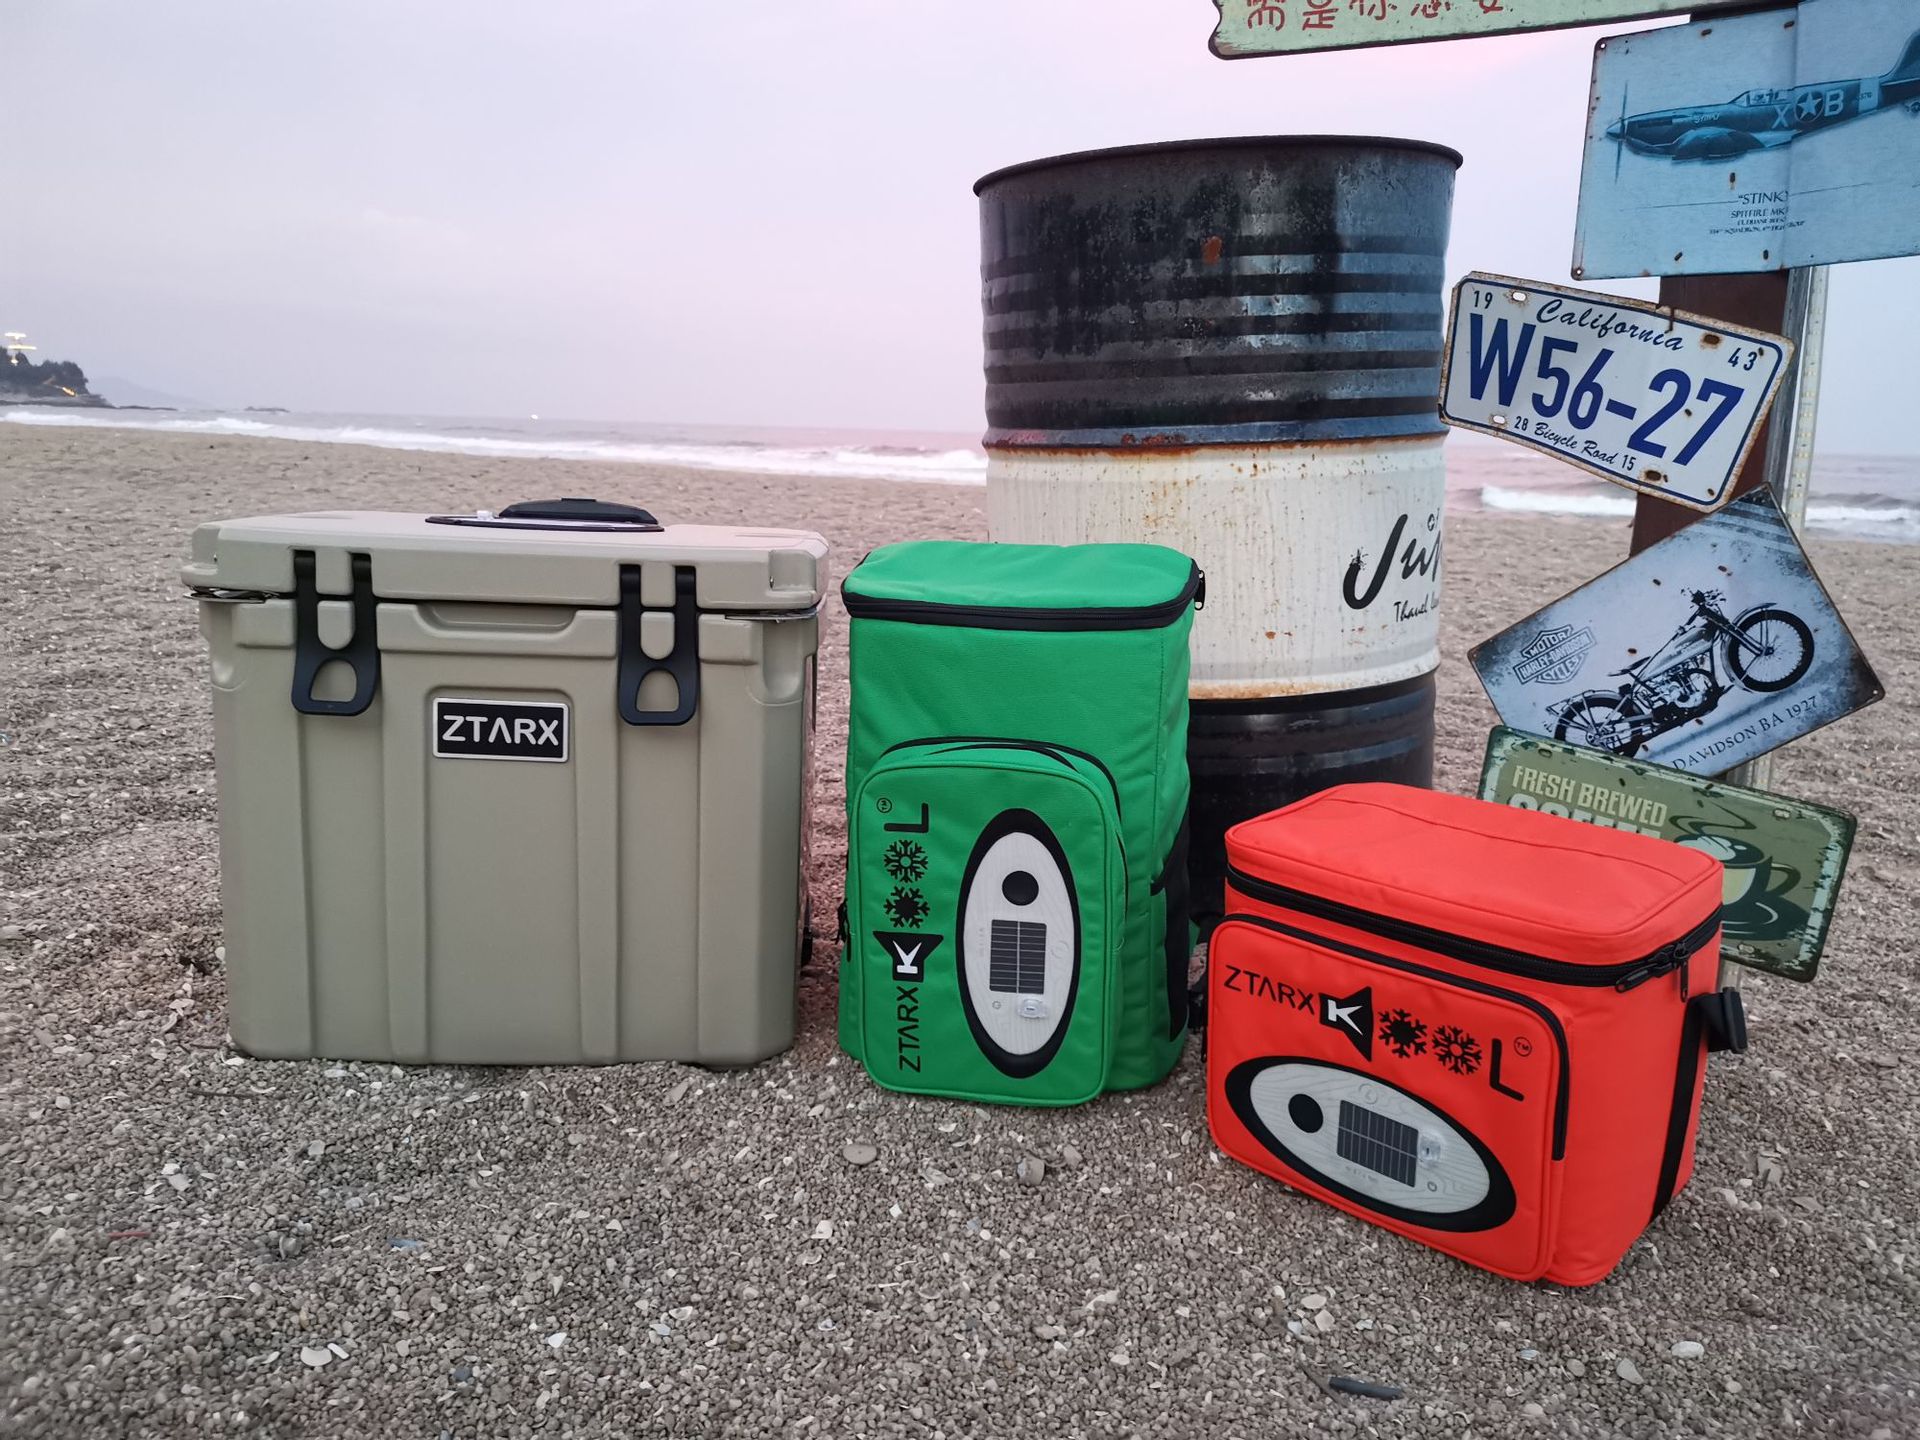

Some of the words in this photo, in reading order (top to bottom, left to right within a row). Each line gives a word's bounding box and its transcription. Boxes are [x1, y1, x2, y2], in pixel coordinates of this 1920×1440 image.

[1473, 289, 1494, 309] 19
[1536, 299, 1684, 351] California
[1727, 346, 1758, 371] 43
[1469, 313, 1745, 466] W56-27
[1514, 415, 1528, 431] 28
[1534, 421, 1578, 450] Bicycle
[1581, 440, 1619, 465] Road
[1621, 454, 1636, 471] 15
[1529, 631, 1567, 656] MOTOR
[1542, 655, 1579, 679] CYCLES
[442, 715, 559, 746] ZTARX
[1672, 725, 1758, 769] DAVIDSON
[1758, 712, 1784, 731] BA
[1785, 696, 1818, 719] 1927
[1512, 765, 1576, 804] FRESH
[1577, 782, 1668, 827] BREWED
[1223, 965, 1315, 1015] ZTARX
[896, 985, 921, 1073] ZTARX
